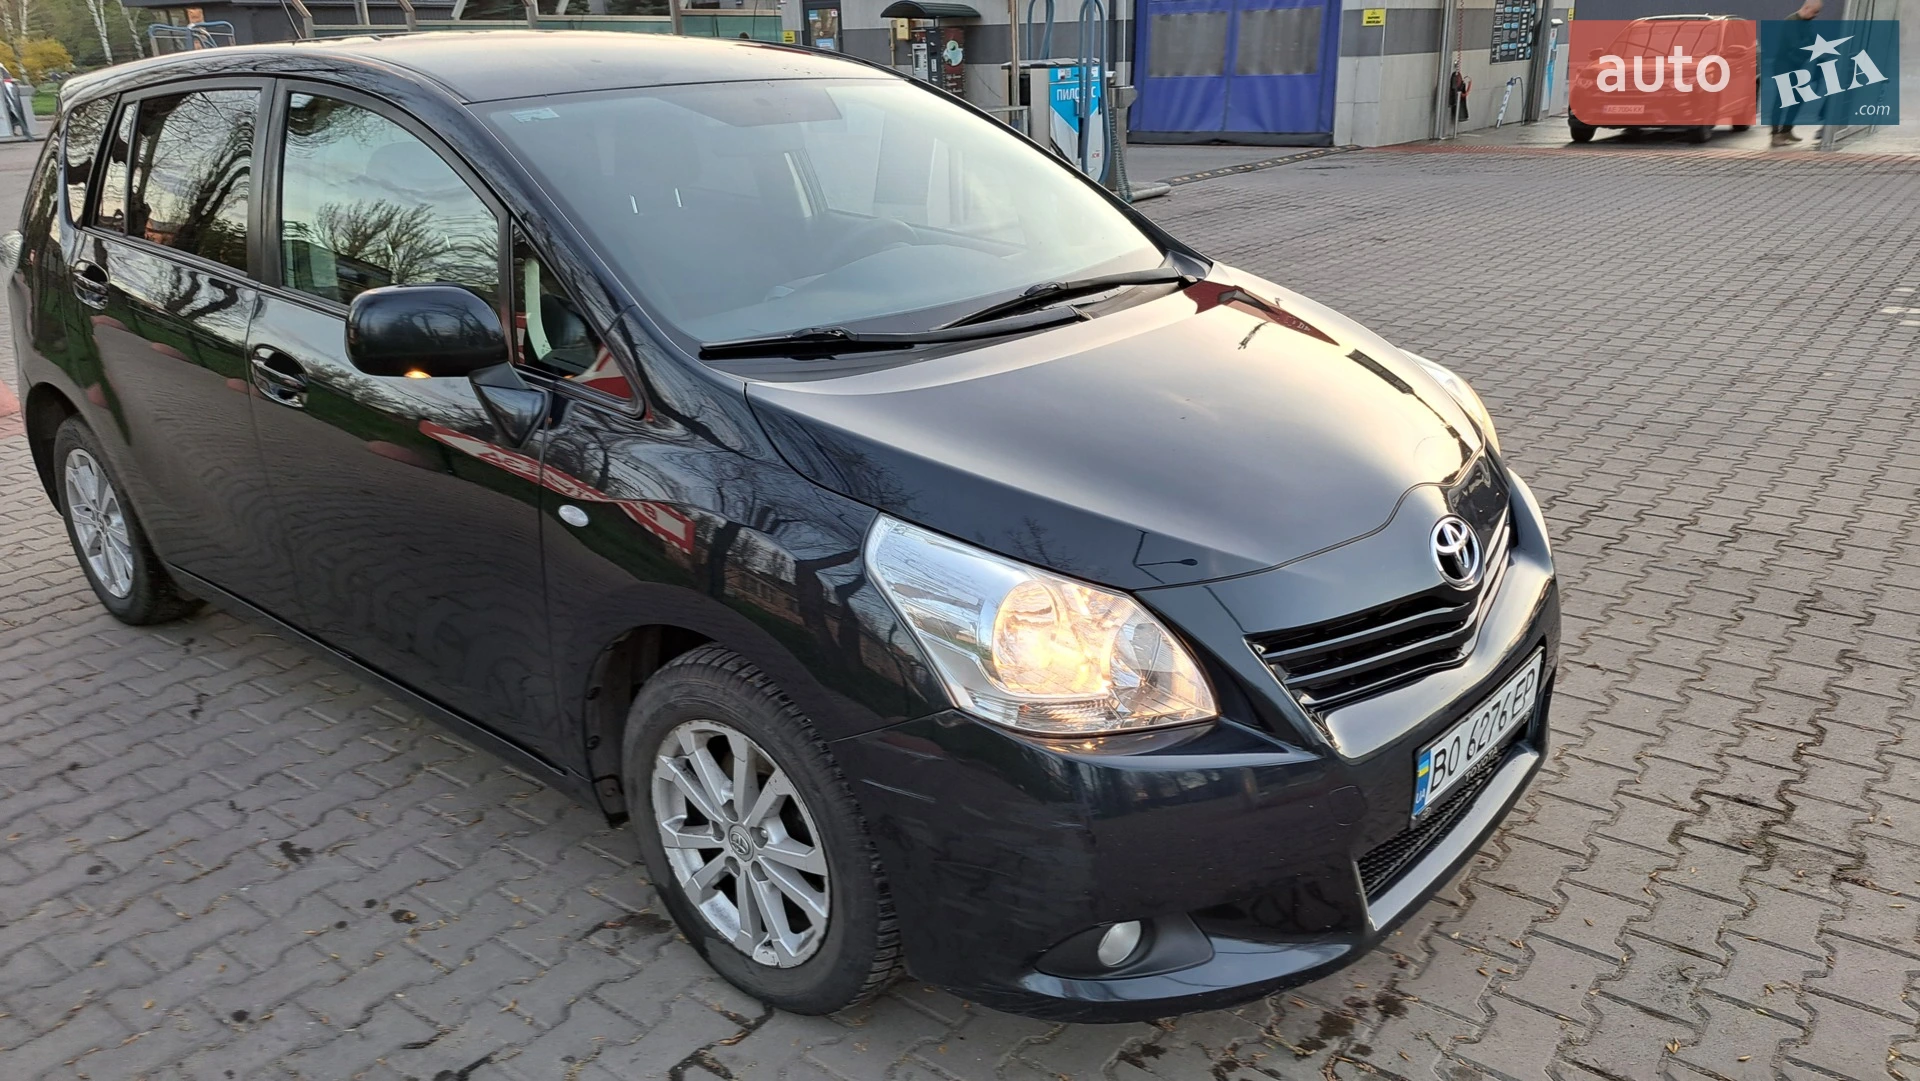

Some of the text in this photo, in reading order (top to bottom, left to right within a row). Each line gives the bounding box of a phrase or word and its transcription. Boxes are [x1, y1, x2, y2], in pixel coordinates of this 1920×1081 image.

[1056, 86, 1097, 101] ПИЛОС
[1429, 668, 1536, 794] BO 6276 EP
[1464, 746, 1499, 784] TOYOTA
